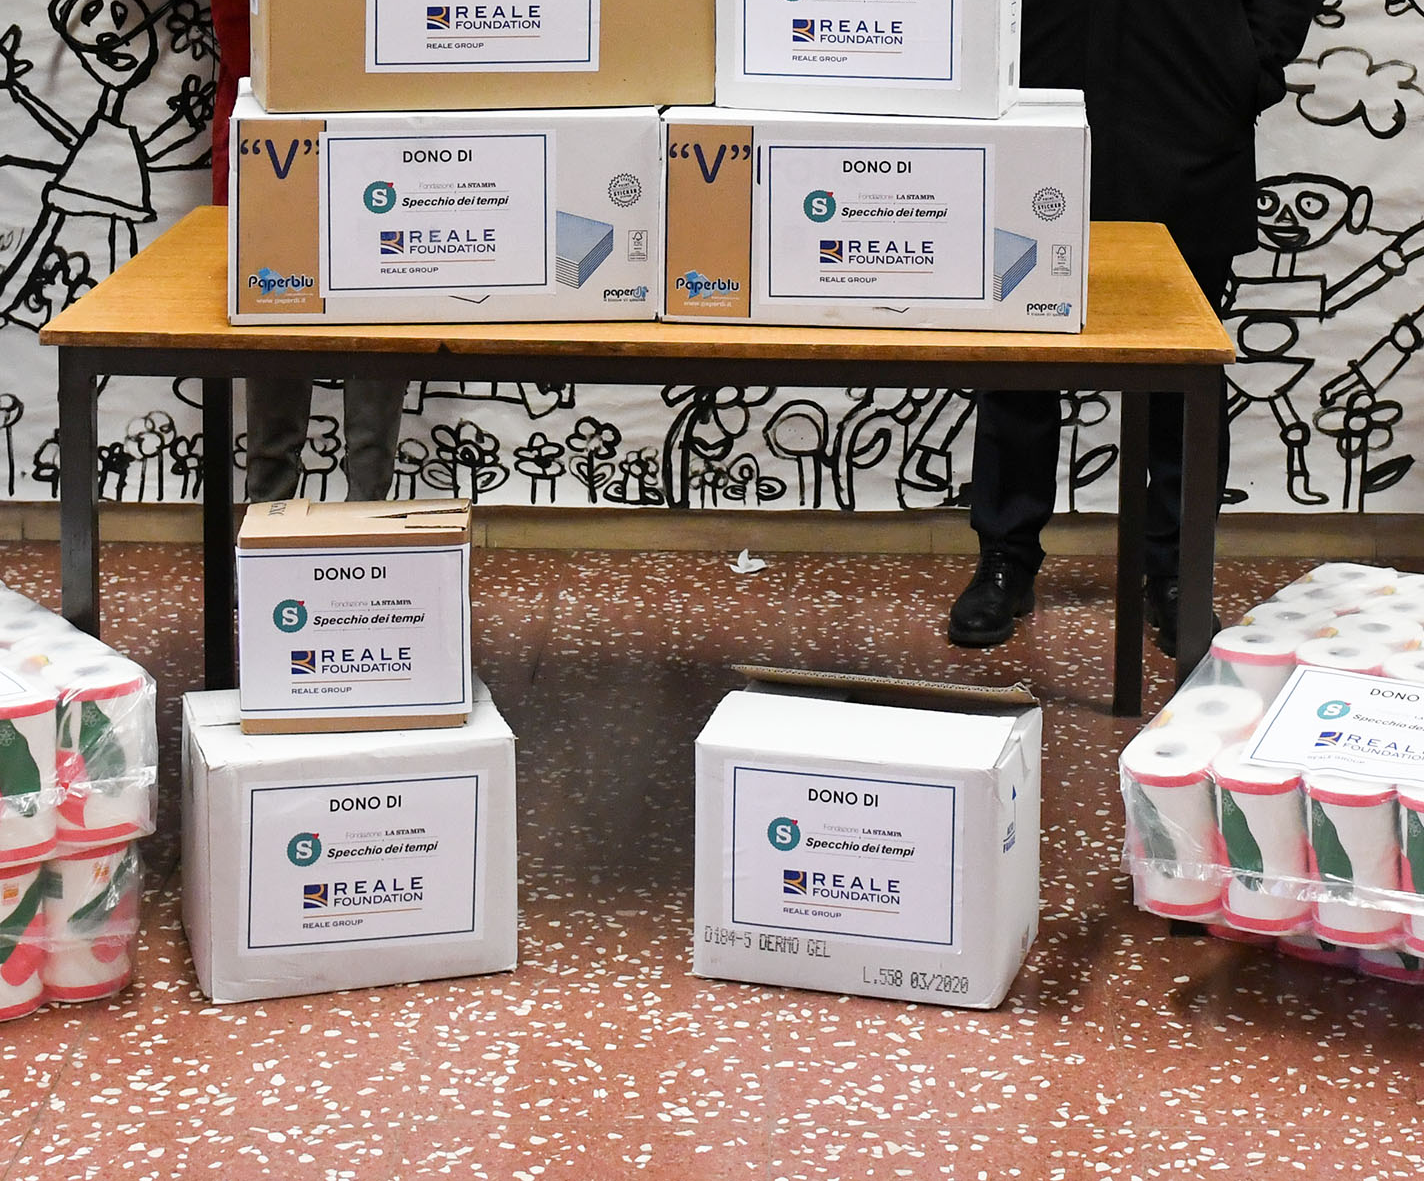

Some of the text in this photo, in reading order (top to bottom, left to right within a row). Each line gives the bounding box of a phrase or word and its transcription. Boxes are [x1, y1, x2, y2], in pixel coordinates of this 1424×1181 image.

[456, 5, 541, 18] REALE
[456, 20, 541, 29] FOUNDATION
[820, 20, 903, 33] REALE
[820, 35, 903, 44] FOUNDATION
[403, 149, 472, 163] DONO DI
[843, 161, 911, 173] DONO DI
[372, 189, 388, 207] S
[614, 189, 637, 197] STICKER
[402, 196, 509, 207] Specchio dei tempi
[812, 198, 827, 215] S
[841, 207, 947, 218] Specchio dei tempi
[409, 229, 496, 243] REALE
[409, 244, 496, 254] FOUNDATION
[849, 241, 934, 253] REALE
[849, 255, 934, 264] FOUNDATION
[249, 276, 313, 292] Paperblu
[676, 278, 739, 292] Paperblu
[314, 566, 386, 581] DONO DI
[282, 607, 299, 626] S
[313, 613, 425, 626] Specchio dei tempi
[321, 647, 411, 662] REALE
[321, 663, 411, 674] FOUNDATION
[1370, 688, 1419, 702] DONO
[1353, 714, 1407, 728] Specchio
[329, 795, 402, 812] DONO DI
[808, 788, 878, 807] DONO DI
[776, 825, 792, 844] S
[873, 829, 902, 837] STAMPA
[296, 840, 313, 859] S
[327, 841, 438, 859] Specchio dei tempi
[806, 838, 915, 857] Specchio dei tempi
[334, 877, 423, 895] REALE
[813, 873, 900, 893] REALE
[334, 892, 422, 907] FOUNDATION
[812, 888, 900, 905] FOUNDATION
[332, 919, 363, 927] GROUP
[759, 933, 799, 954] DERMO
[807, 939, 831, 957] GEL
[863, 966, 969, 994] L.558 03/2020
